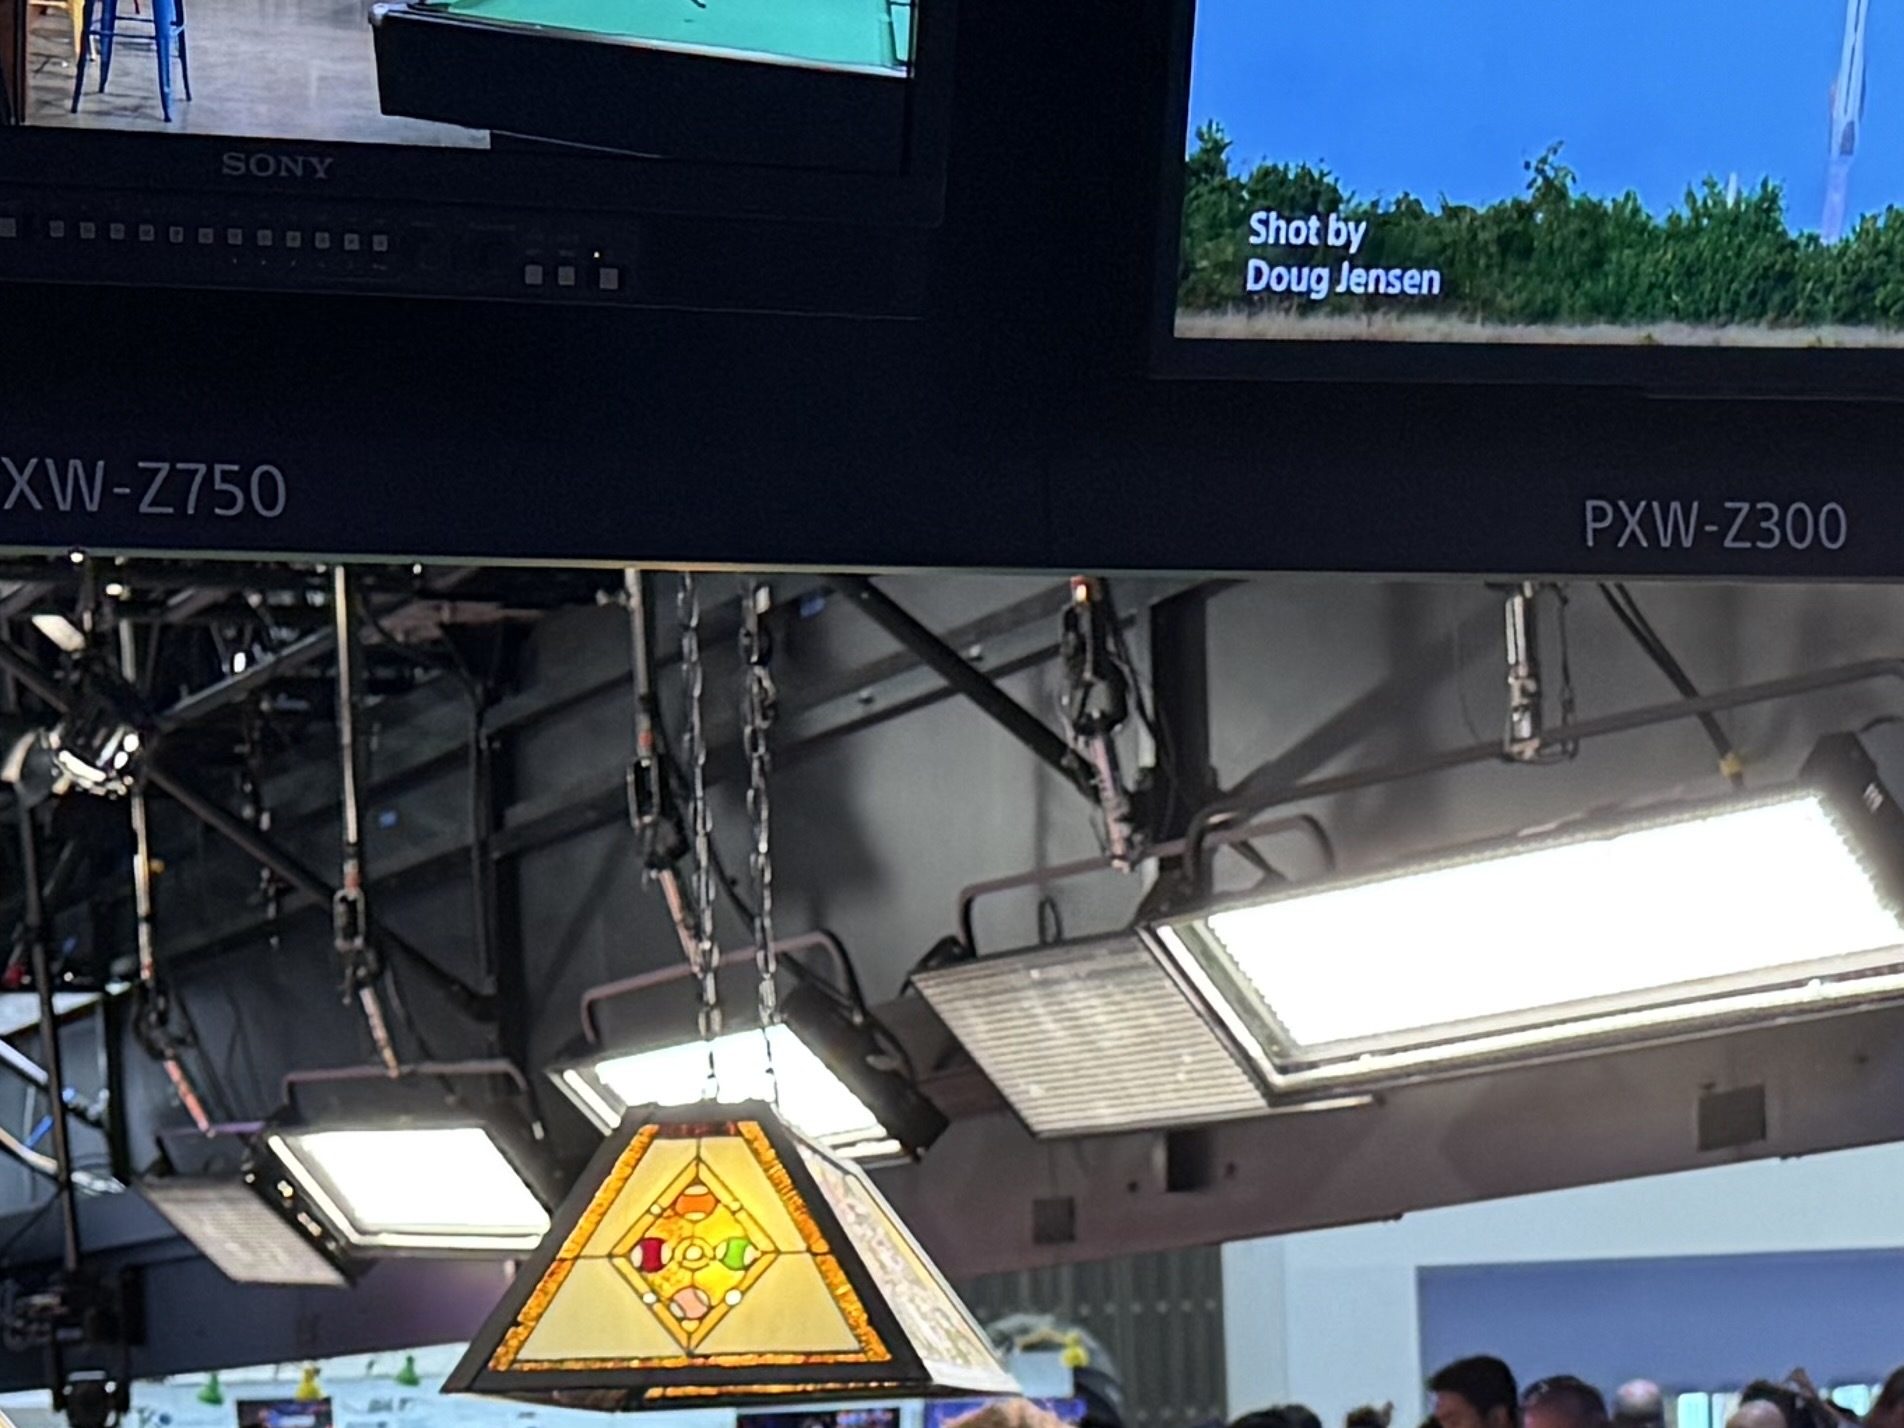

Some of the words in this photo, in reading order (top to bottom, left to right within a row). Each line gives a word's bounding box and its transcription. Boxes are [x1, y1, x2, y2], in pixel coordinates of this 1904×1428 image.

[220, 151, 333, 181] SONY
[1248, 211, 1322, 248] Shot
[1328, 212, 1366, 255] by
[1245, 259, 1330, 303] Doug
[1335, 260, 1441, 297] Jensen
[1584, 498, 1848, 552] PXW-Z300
